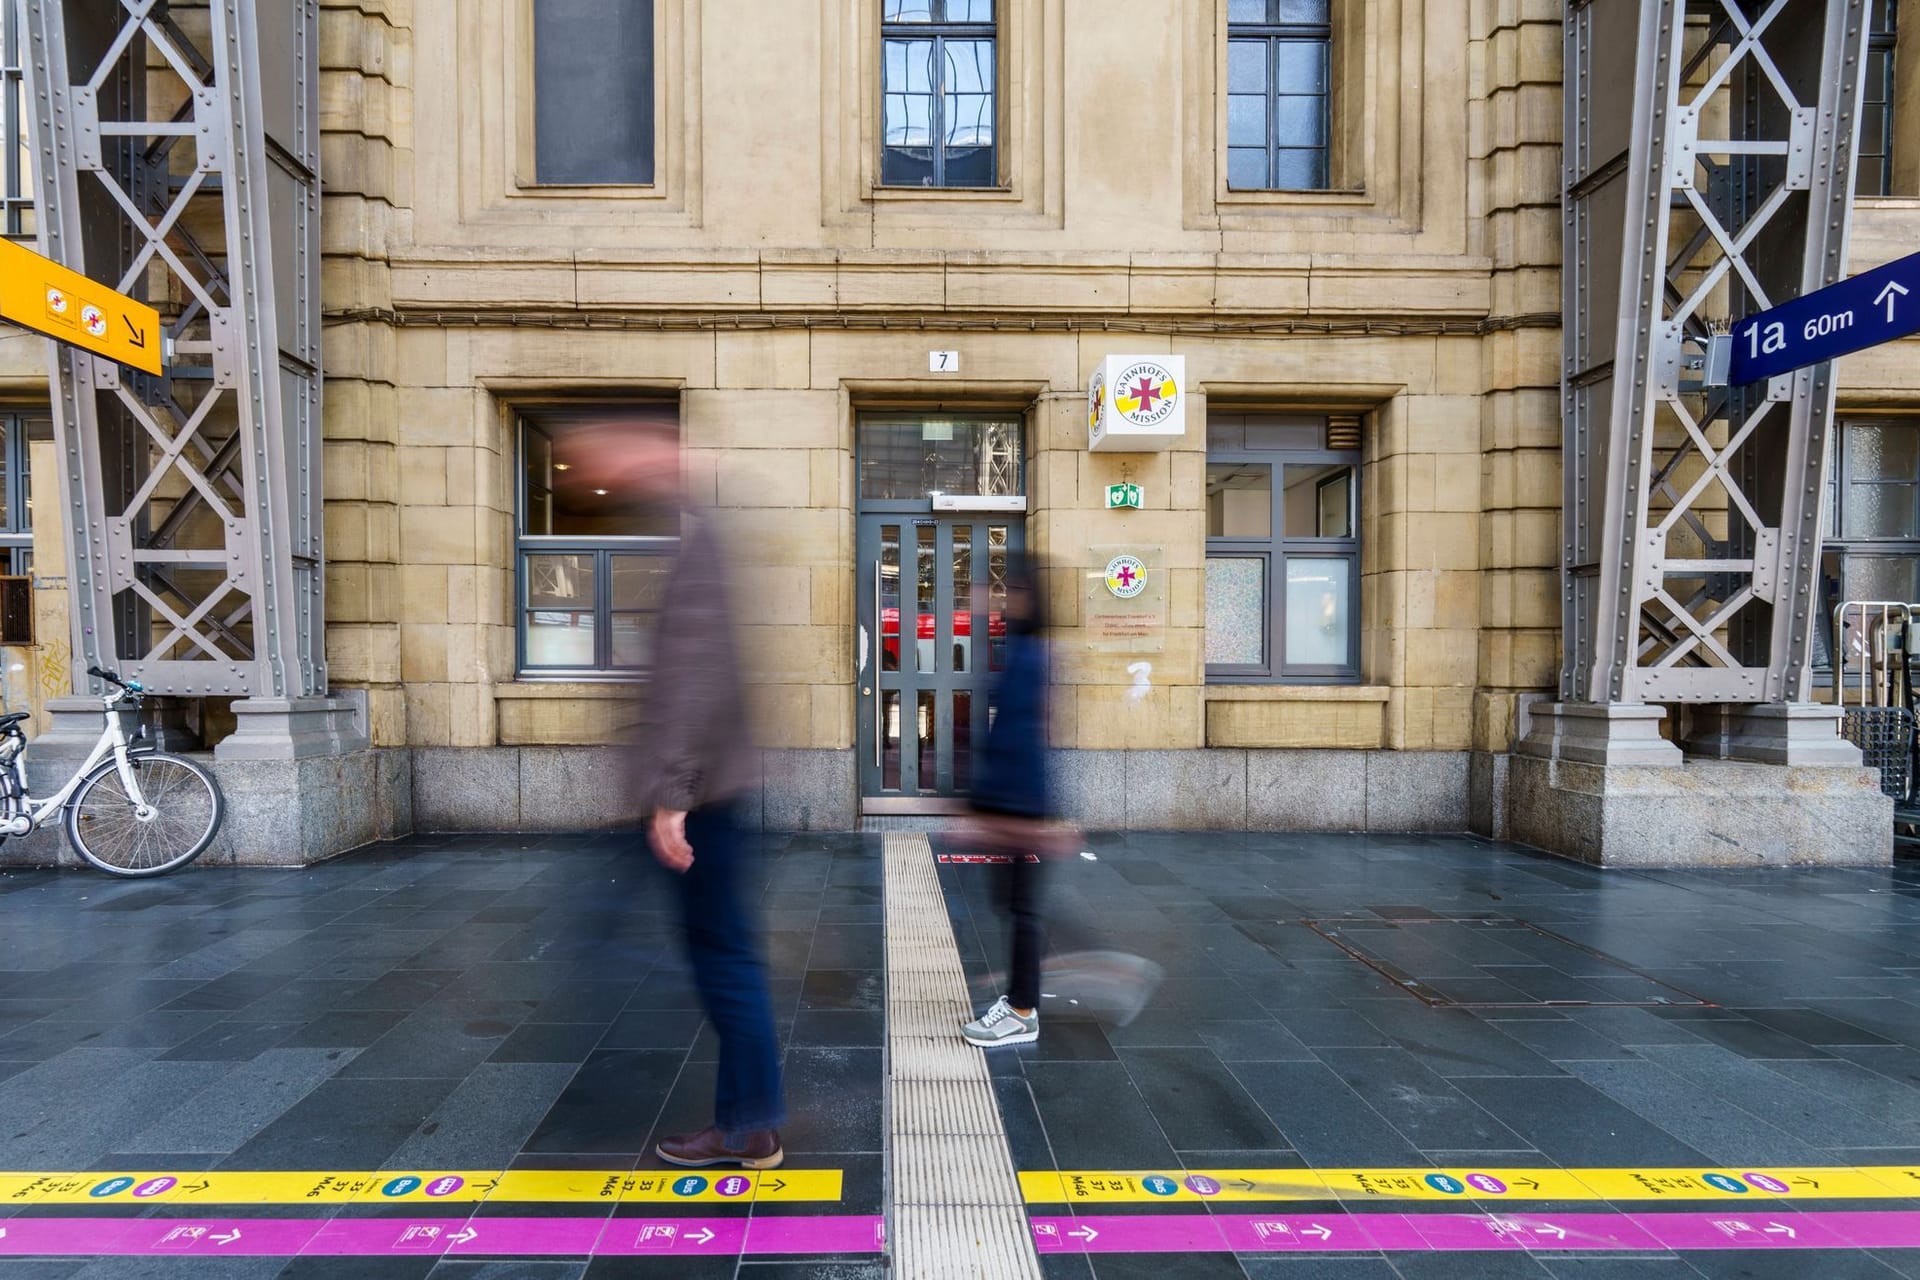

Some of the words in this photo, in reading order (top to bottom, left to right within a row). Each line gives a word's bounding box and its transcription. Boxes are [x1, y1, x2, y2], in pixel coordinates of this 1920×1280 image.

[1743, 321, 1787, 359] 1a
[1804, 310, 1853, 340] 60m
[939, 354, 948, 369] 7
[1117, 366, 1168, 396] BAHNHOFS
[1130, 399, 1173, 423] MISSION
[306, 1176, 336, 1197] M46
[332, 1181, 349, 1192] 37
[350, 1181, 365, 1192] 33
[392, 1179, 413, 1194] Bus
[600, 1176, 620, 1197] M46
[622, 1180, 636, 1191] 37
[640, 1180, 654, 1191] 33
[683, 1179, 698, 1194] Bus
[1070, 1176, 1088, 1197] M46
[1090, 1180, 1106, 1191] 37
[1109, 1180, 1123, 1191] 33
[1152, 1179, 1166, 1193] Bus
[1352, 1174, 1380, 1194] M46
[1374, 1178, 1393, 1189] 37
[1392, 1178, 1410, 1189] 33
[1434, 1177, 1455, 1192] Bus
